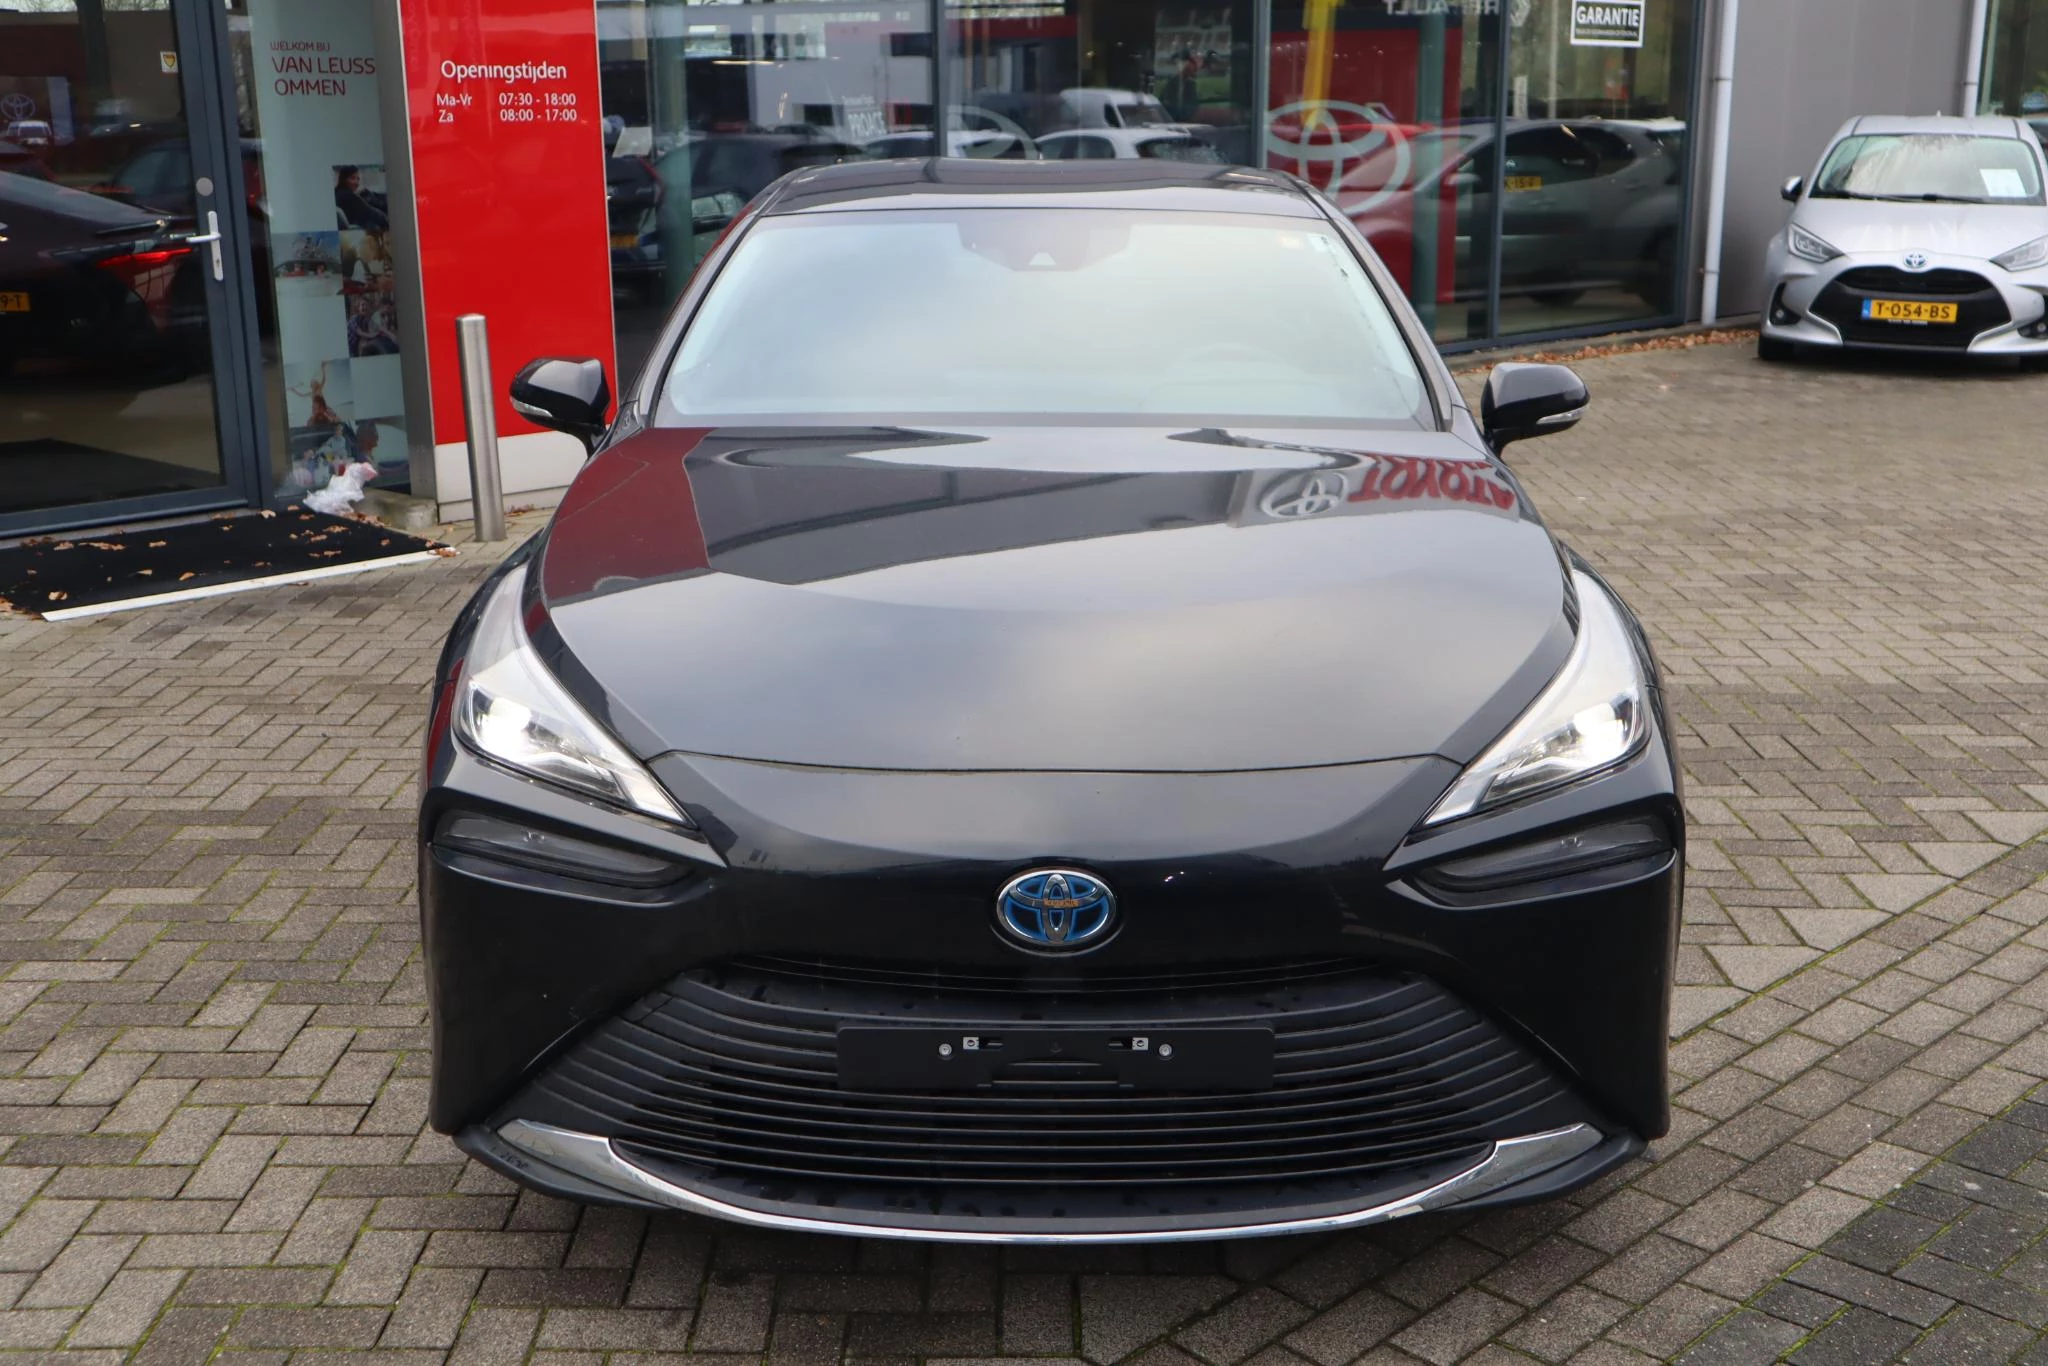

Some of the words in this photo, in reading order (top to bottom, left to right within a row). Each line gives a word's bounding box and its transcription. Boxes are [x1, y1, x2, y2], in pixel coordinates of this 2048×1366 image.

[1576, 6, 1640, 27] GARANTIE
[270, 41, 314, 51] WELKOM
[272, 56, 312, 73] VAN
[317, 57, 376, 75] LEUSS
[441, 60, 567, 84] Openingstijden
[274, 78, 346, 96] OMMEN
[436, 93, 472, 106] Ma-Vr
[499, 93, 533, 106] 07:30
[544, 93, 577, 106] 18:00
[438, 109, 454, 123] Za
[500, 109, 533, 122] 08:00
[545, 109, 577, 122] 17:00
